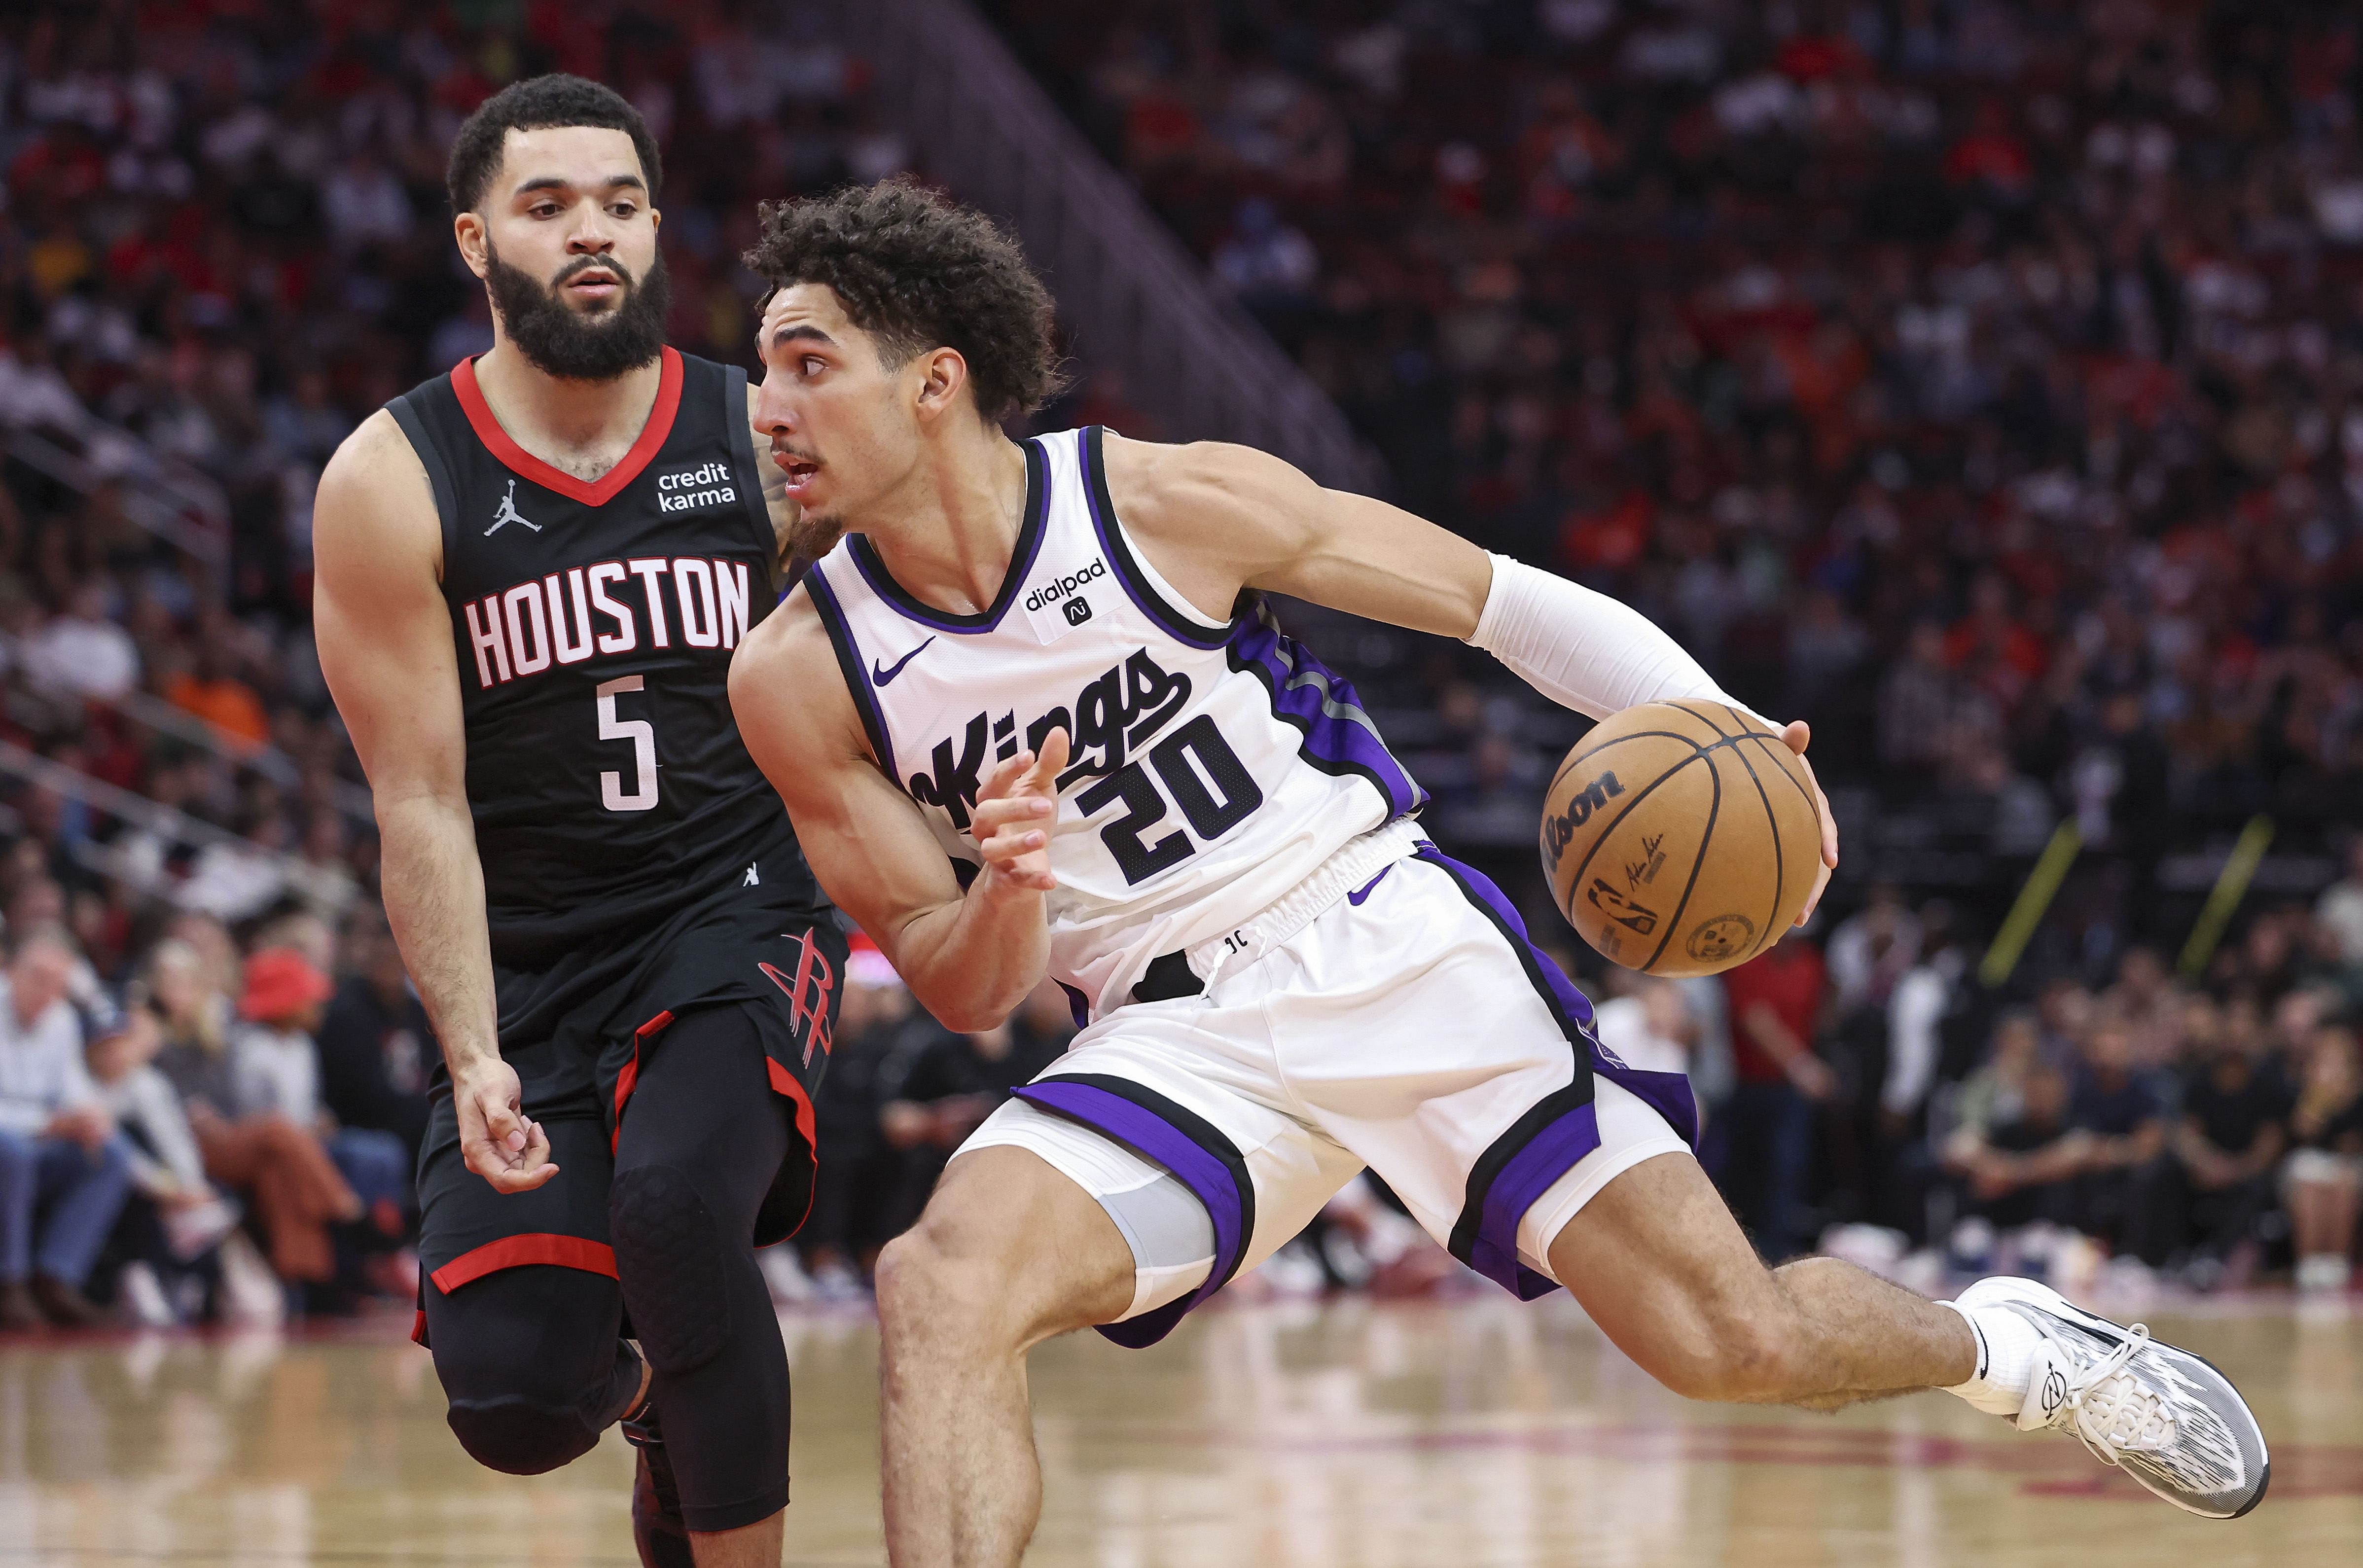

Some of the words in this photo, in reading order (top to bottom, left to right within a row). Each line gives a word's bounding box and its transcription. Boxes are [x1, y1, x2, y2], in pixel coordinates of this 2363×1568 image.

[657, 487, 736, 513] karma
[658, 463, 730, 491] credit
[463, 556, 750, 689] HOUSTON
[1026, 557, 1107, 611] dialpad
[596, 675, 659, 811] 5
[909, 646, 1192, 830] Kings
[1074, 713, 1263, 887] 20
